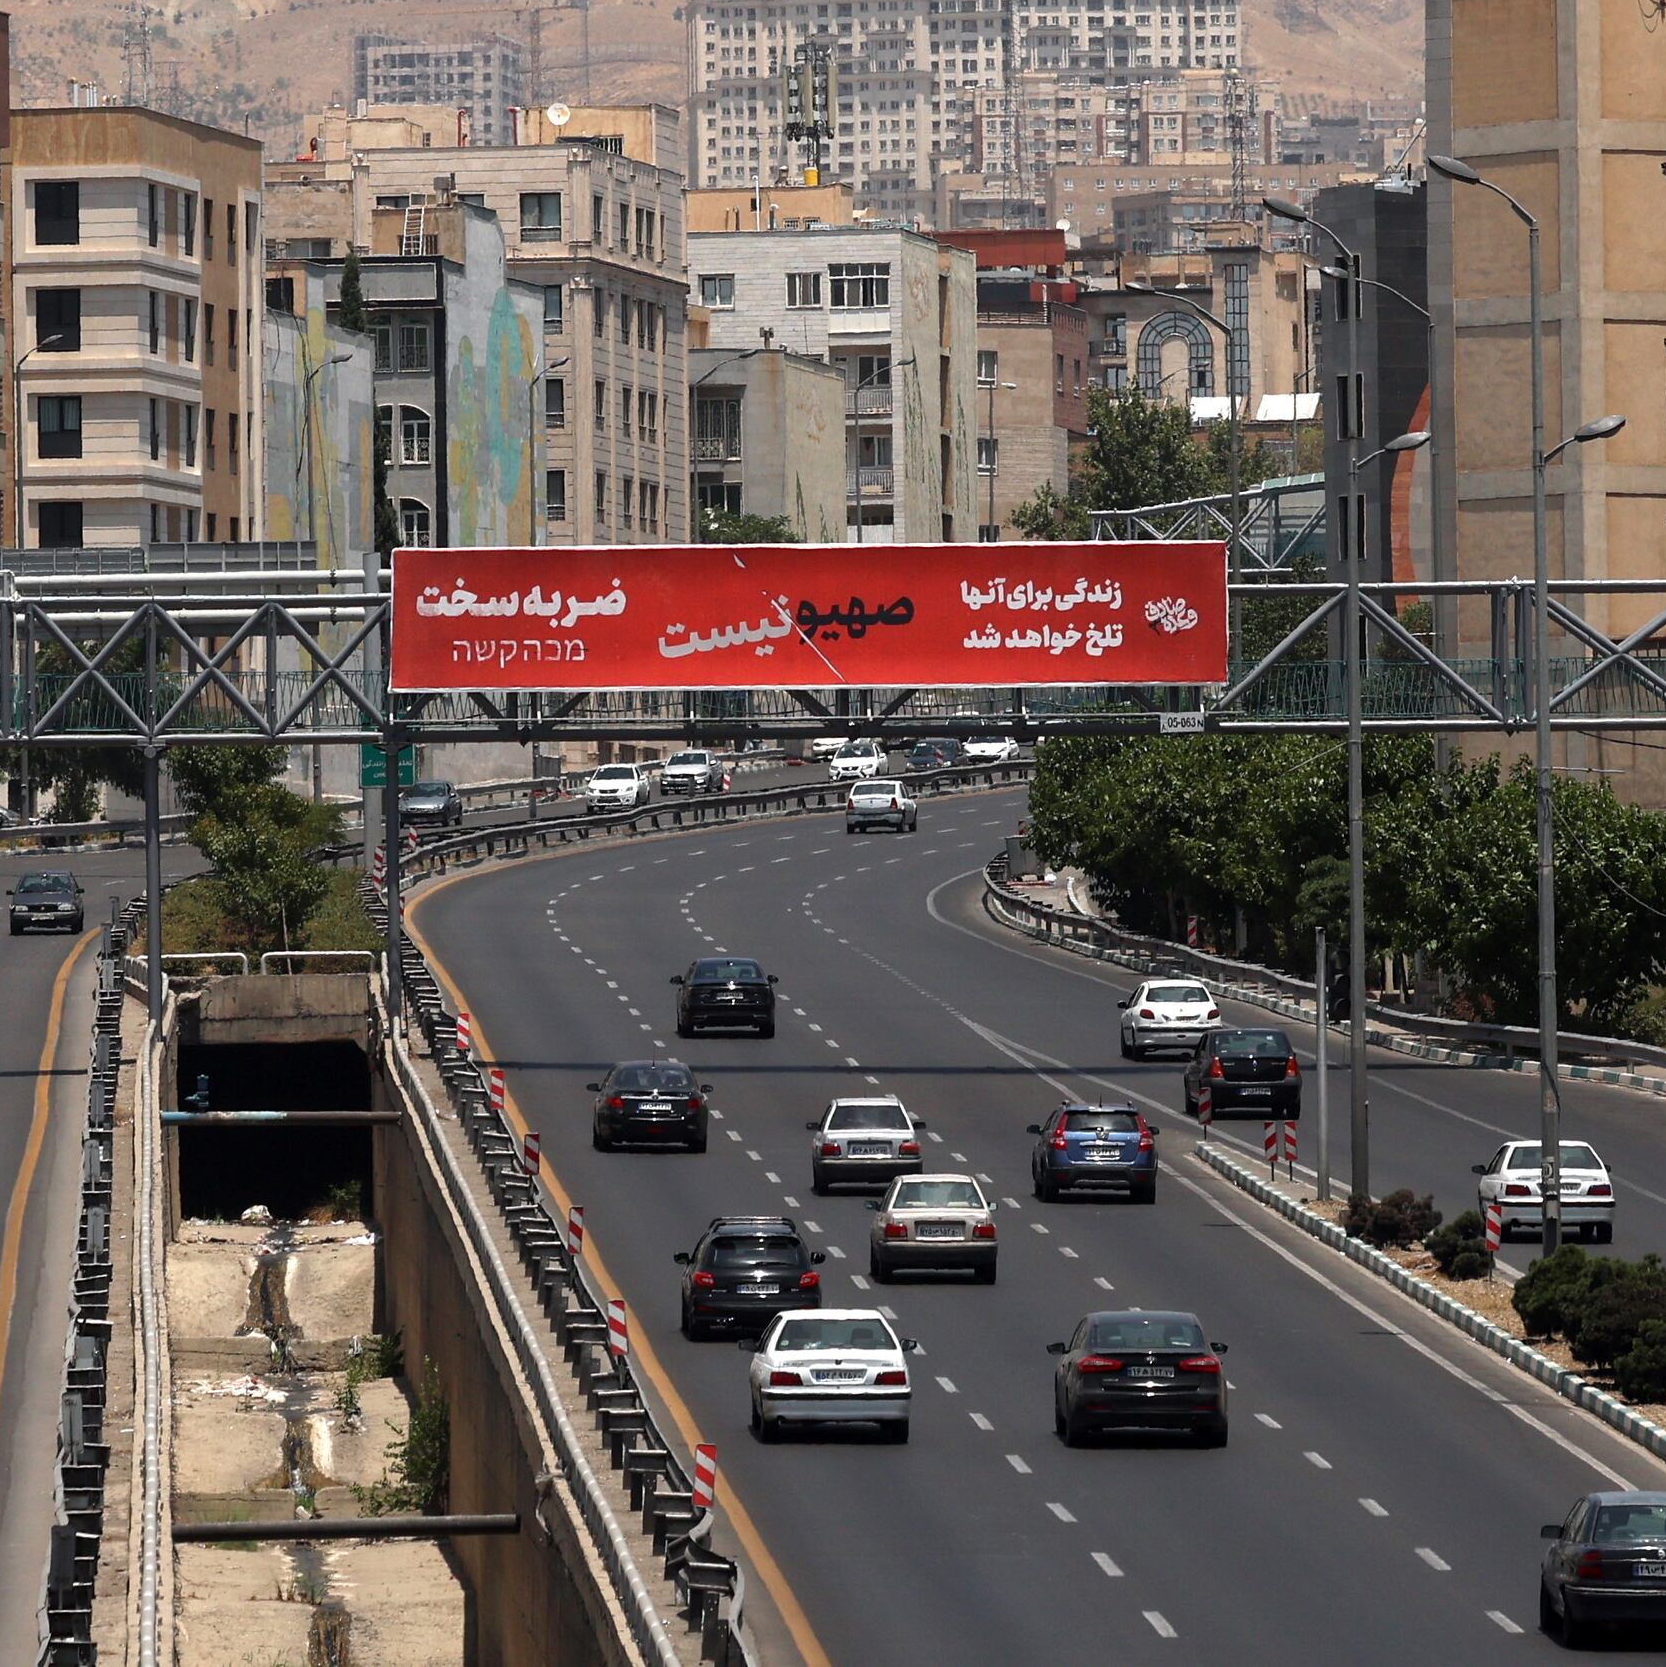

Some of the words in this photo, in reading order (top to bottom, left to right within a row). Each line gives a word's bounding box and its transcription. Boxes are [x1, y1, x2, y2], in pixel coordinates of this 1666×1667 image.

[416, 577, 520, 617] سخت
[522, 577, 627, 628] ضربه
[960, 577, 1006, 610] آنها
[1006, 580, 1053, 611] برای
[1054, 577, 1123, 611] زندگی
[963, 622, 1002, 650] شد
[1004, 623, 1083, 655] خواهد
[1085, 623, 1124, 657] تلخ
